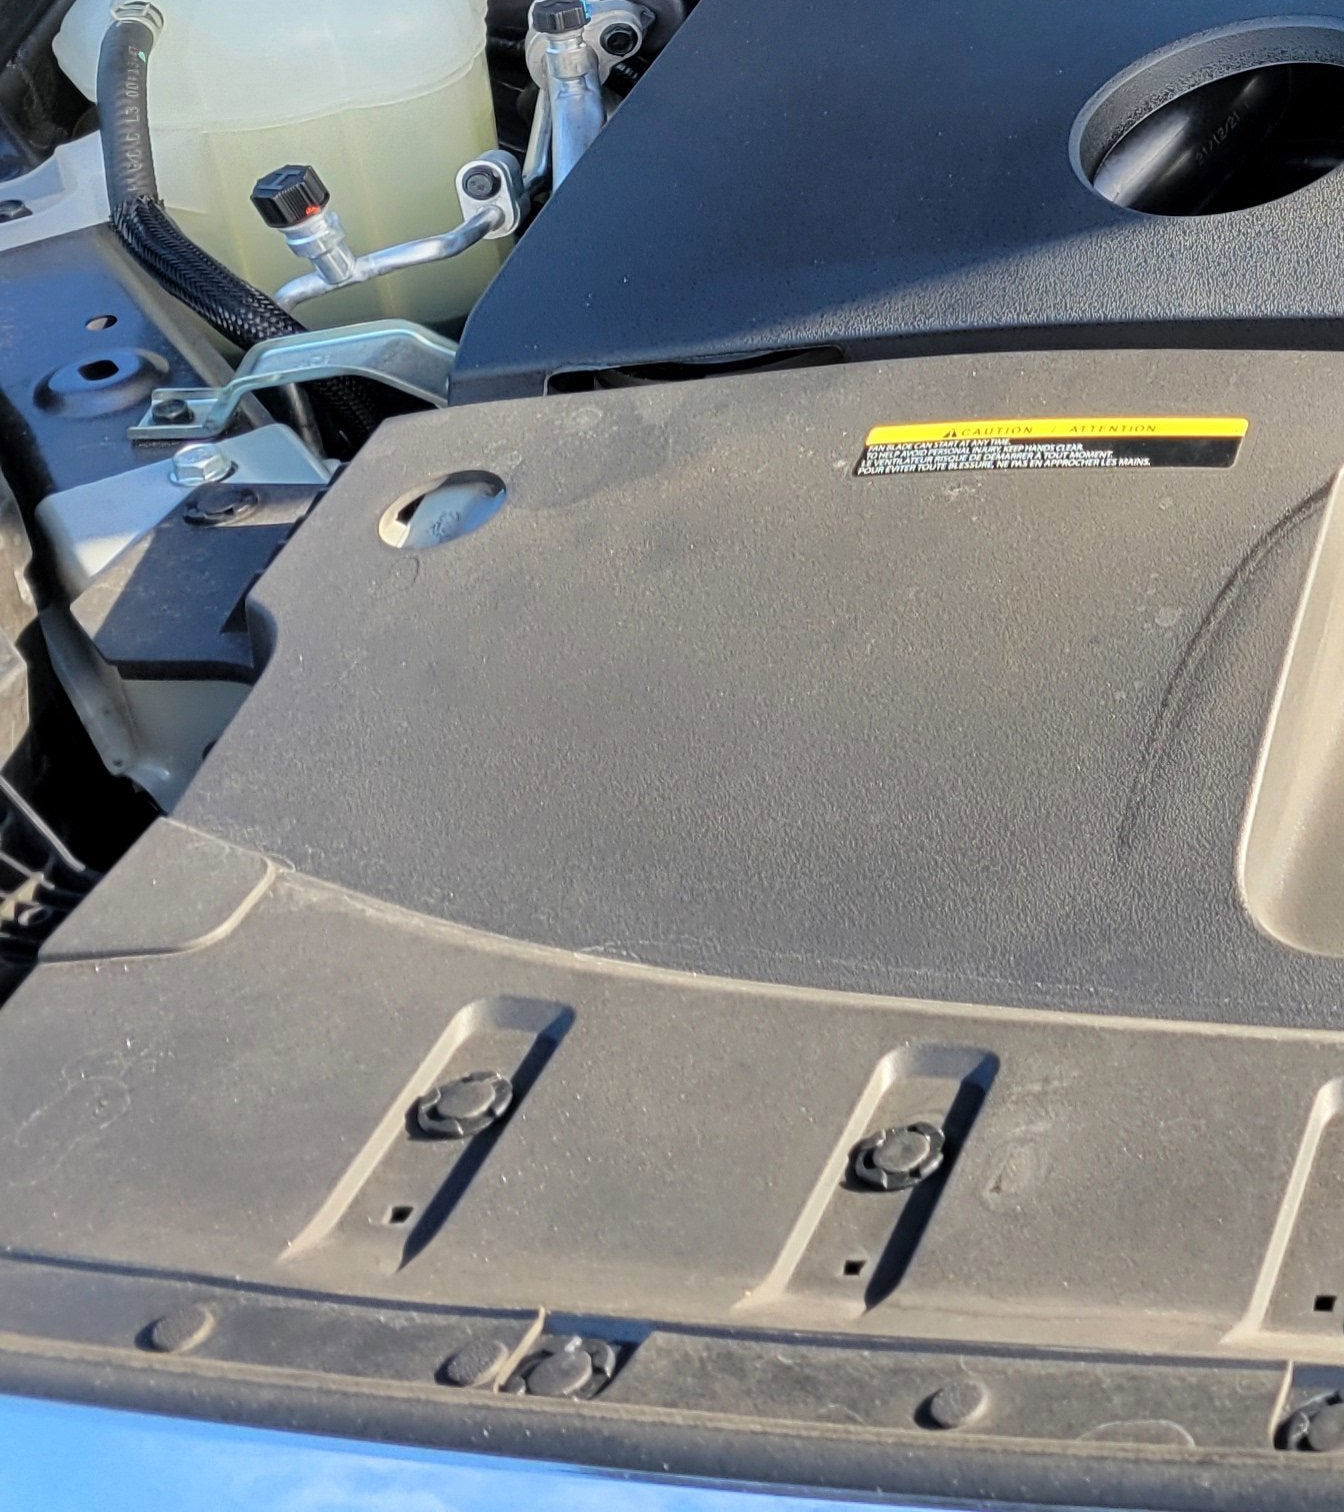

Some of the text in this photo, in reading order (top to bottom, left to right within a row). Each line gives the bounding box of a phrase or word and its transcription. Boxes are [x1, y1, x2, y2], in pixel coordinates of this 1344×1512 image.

[961, 426, 1033, 437] CAUTION
[1069, 425, 1157, 433] ATTENTION
[928, 447, 971, 456] PERSONAL
[1025, 443, 1055, 452] HANDS
[874, 456, 932, 466] VENTILATEUR
[918, 462, 947, 471] TOUTE
[1043, 458, 1101, 467] APPROCHER
